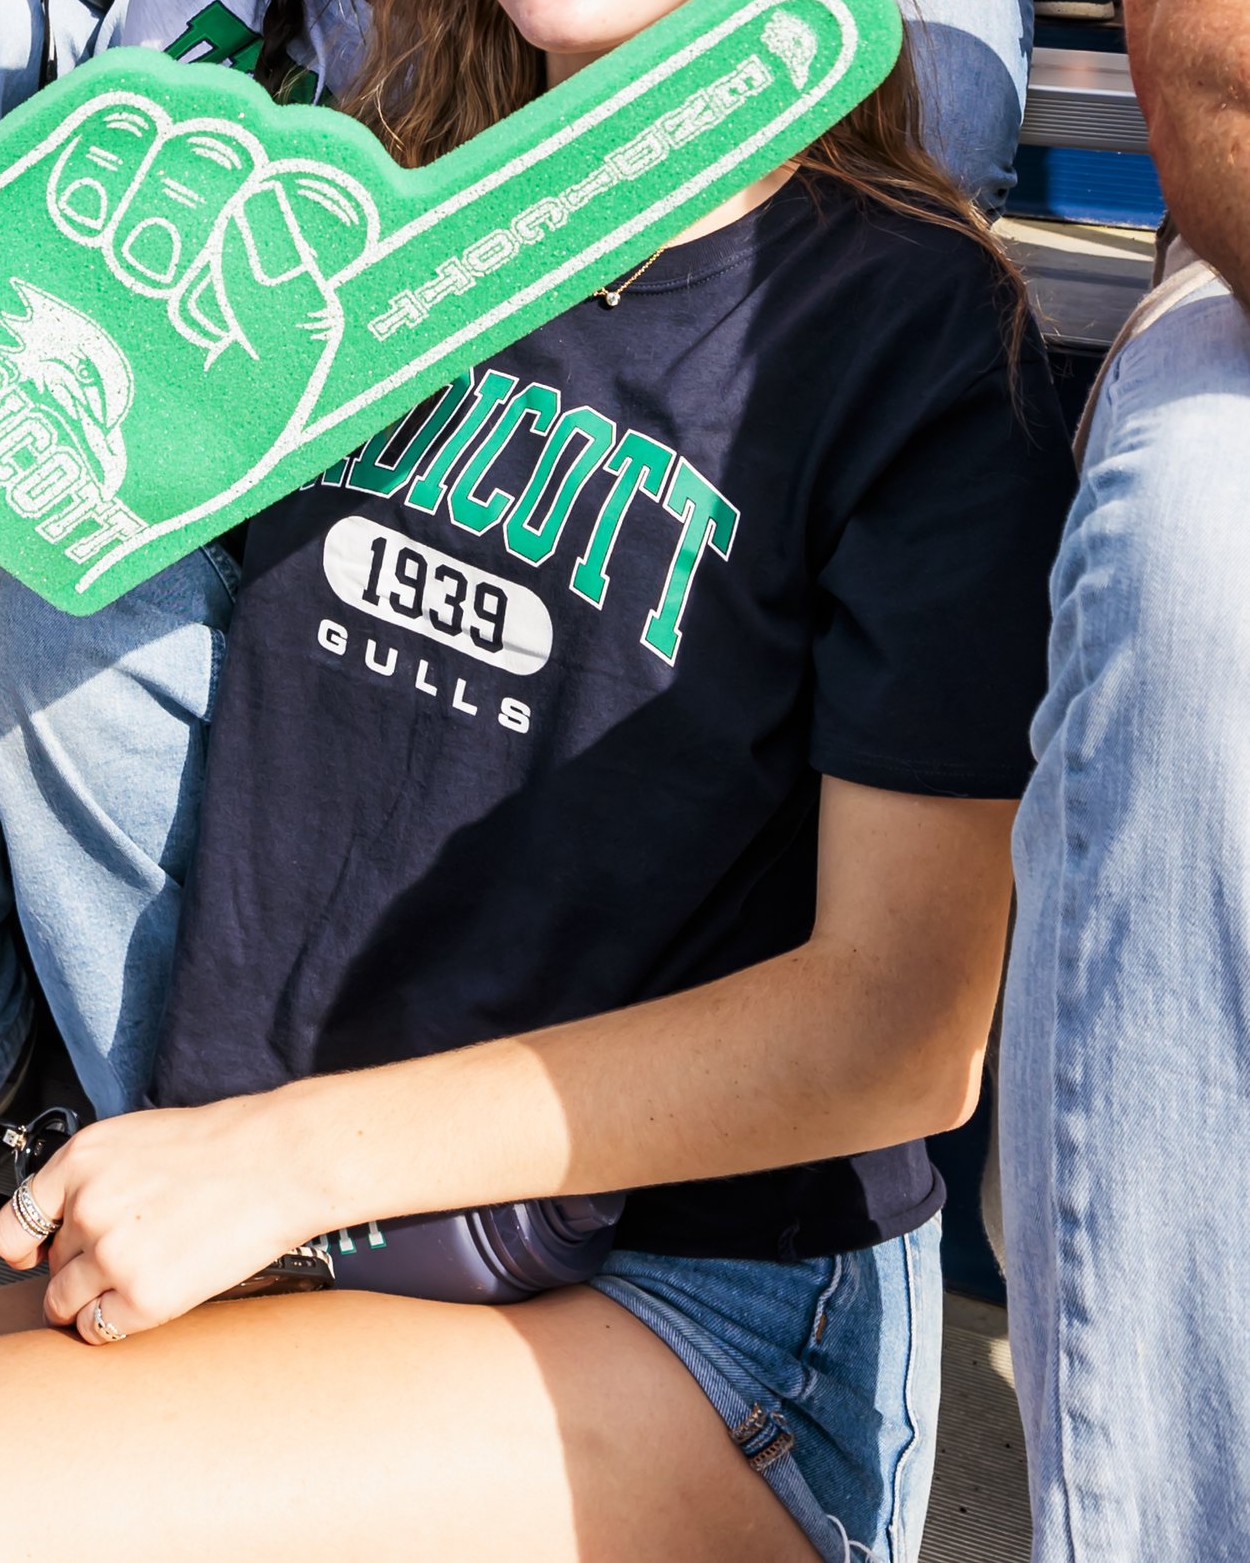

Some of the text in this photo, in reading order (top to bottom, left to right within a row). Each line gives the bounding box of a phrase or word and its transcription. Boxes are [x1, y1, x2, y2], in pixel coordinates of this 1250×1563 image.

[367, 54, 774, 342] ENDICOTT
[362, 536, 508, 654] 1939
[317, 618, 531, 734] GULLS
